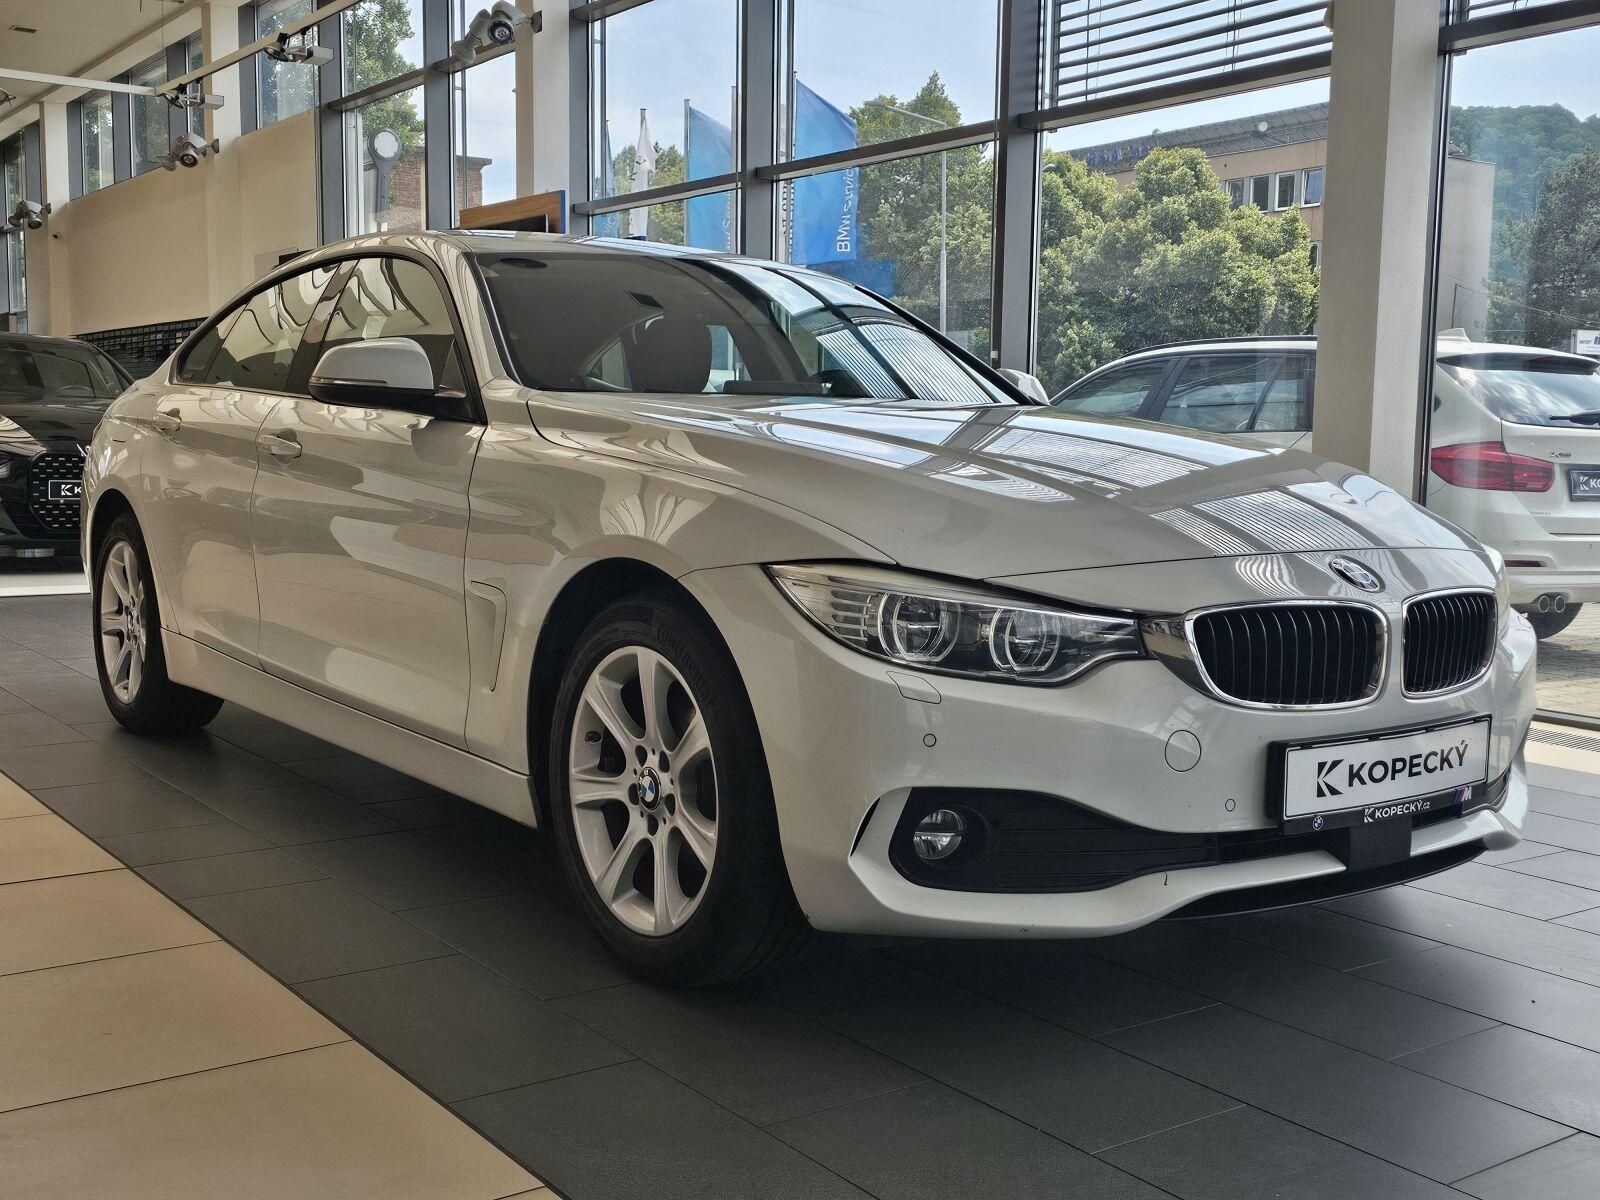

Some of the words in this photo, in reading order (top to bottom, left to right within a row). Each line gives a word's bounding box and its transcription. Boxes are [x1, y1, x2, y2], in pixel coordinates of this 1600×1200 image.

[837, 215, 851, 252] BMW
[844, 168, 855, 212] Servic
[1348, 739, 1469, 788] KOPECKÝ
